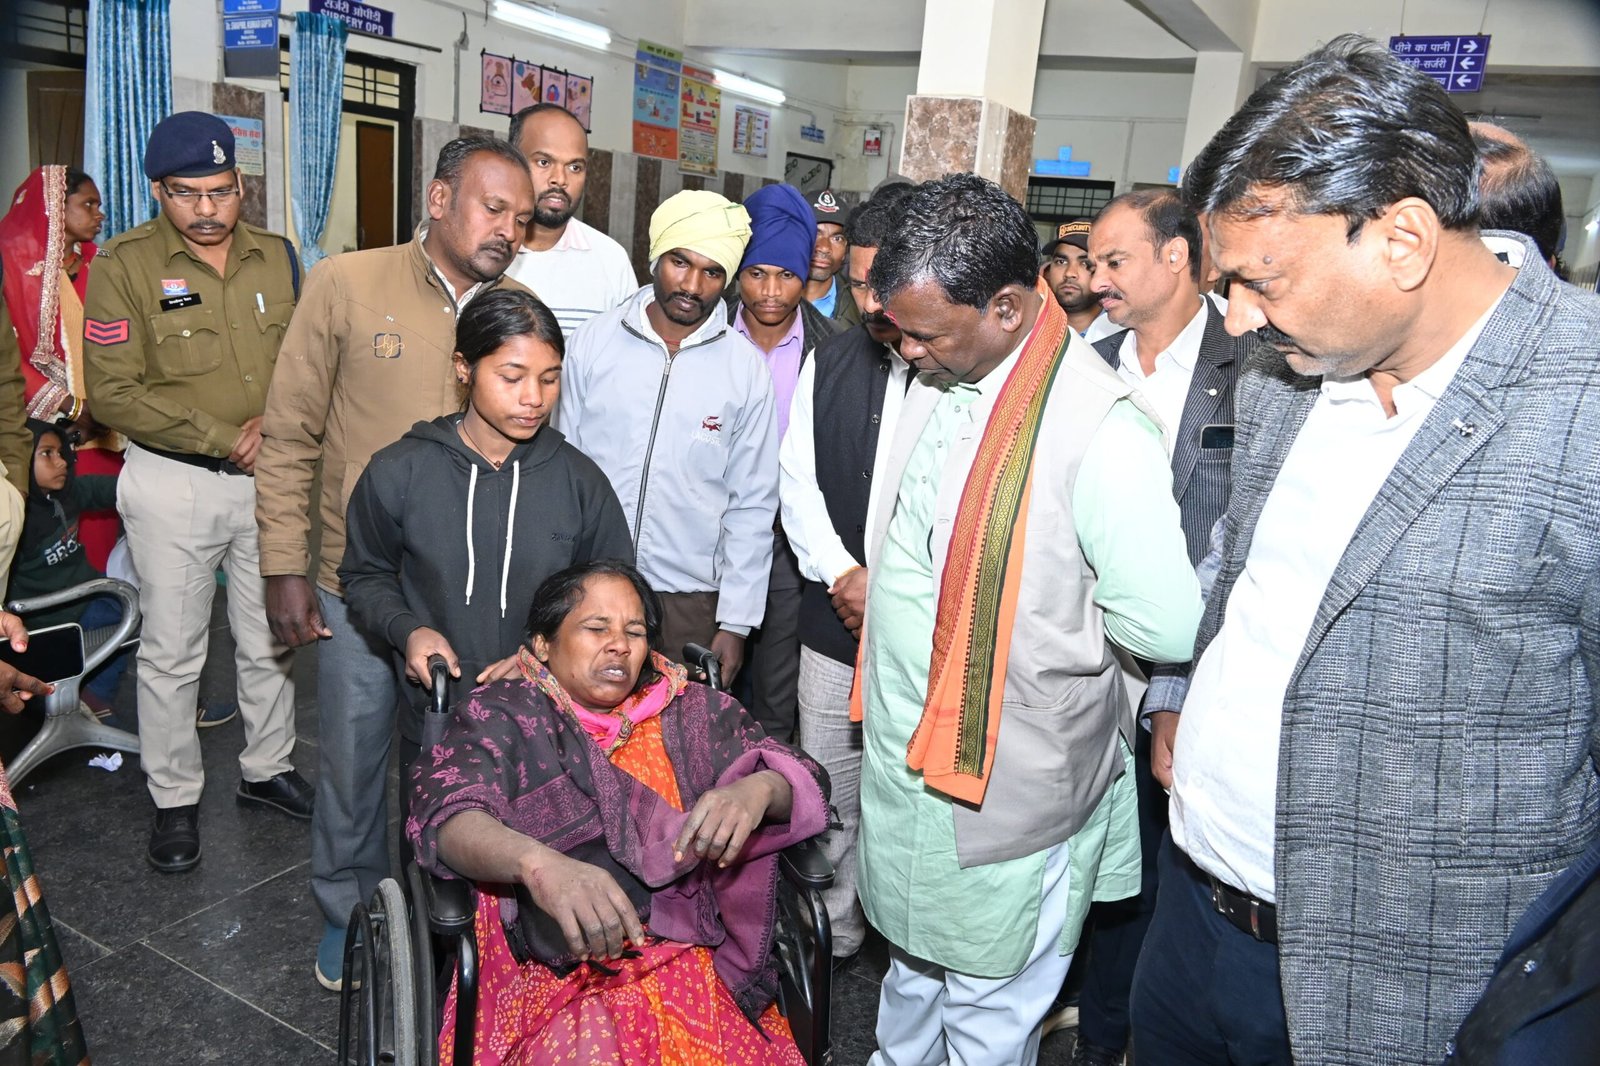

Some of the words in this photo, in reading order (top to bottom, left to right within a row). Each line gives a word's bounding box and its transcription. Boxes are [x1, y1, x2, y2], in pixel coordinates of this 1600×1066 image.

[365, 21, 384, 35] OPD
[1394, 41, 1412, 52] पीने
[1414, 43, 1427, 52] का
[1430, 41, 1451, 52] पानी
